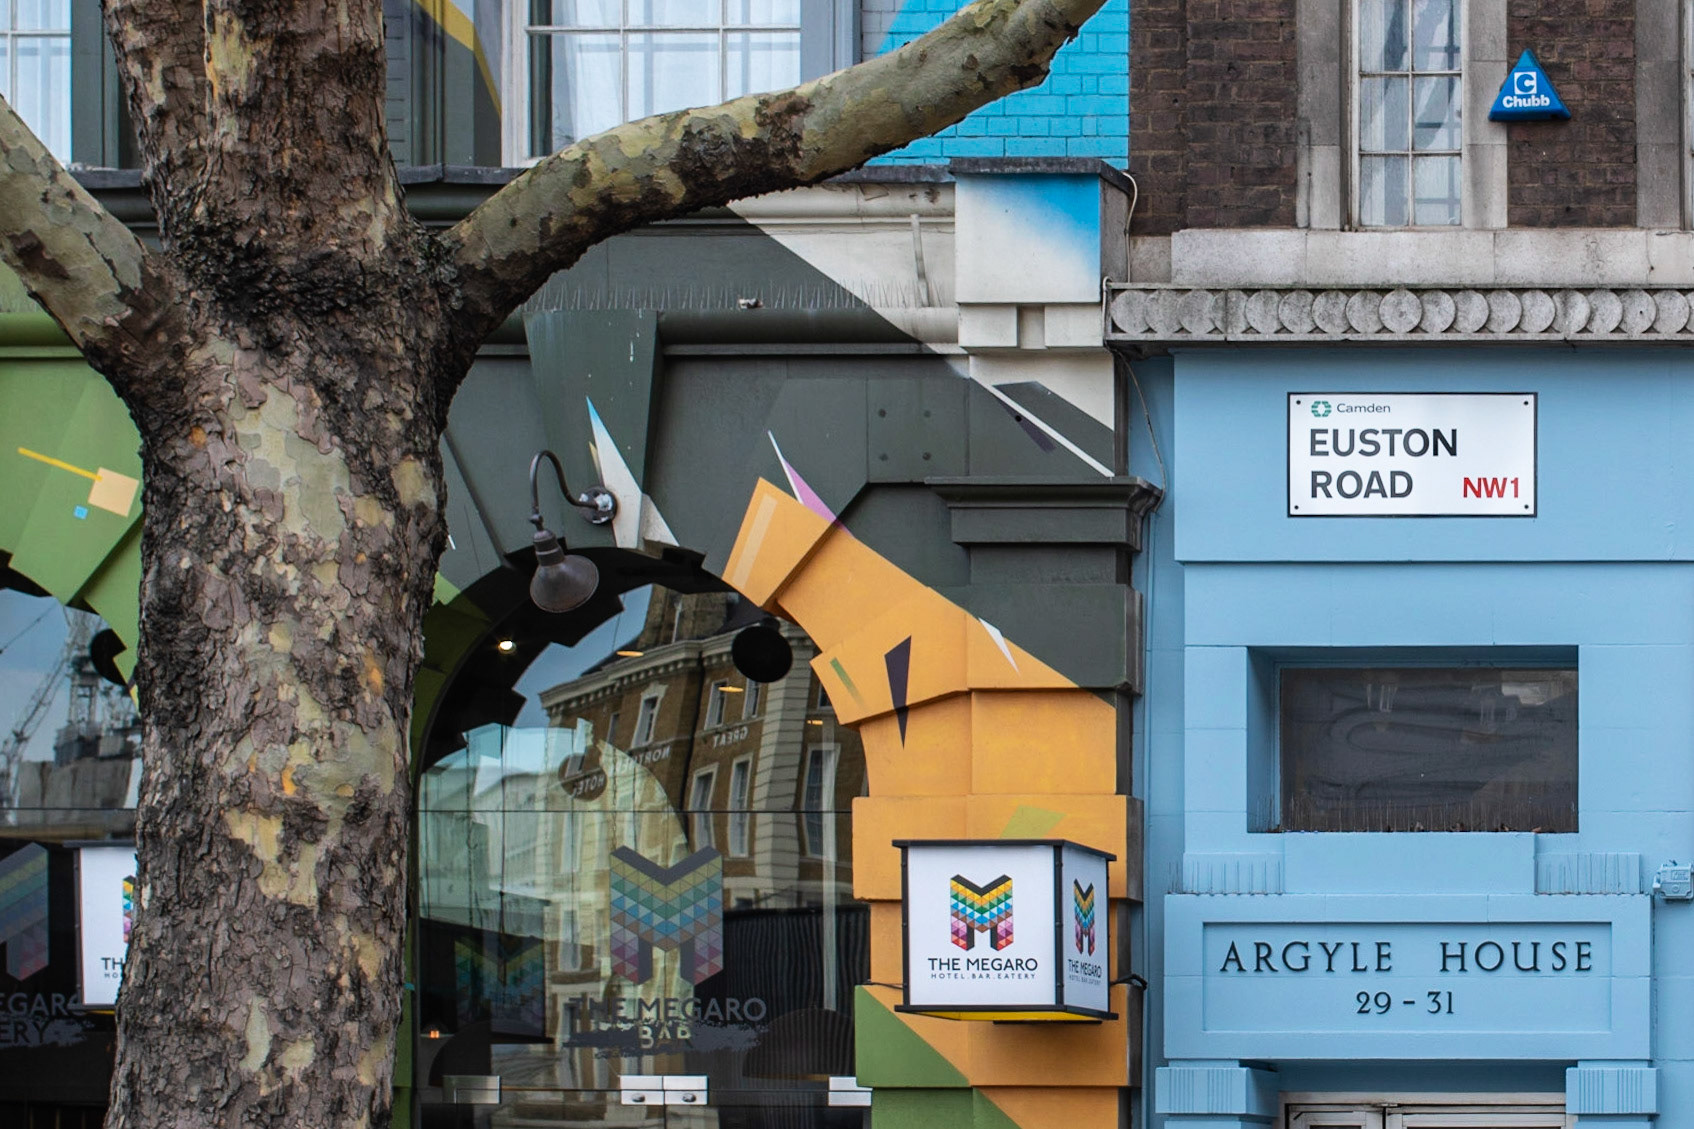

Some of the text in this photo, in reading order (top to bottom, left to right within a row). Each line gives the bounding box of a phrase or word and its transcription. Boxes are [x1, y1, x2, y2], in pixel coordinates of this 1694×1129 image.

[1502, 94, 1551, 108] Chubb
[1336, 402, 1391, 414] Camden
[1310, 428, 1457, 457] EUSTON
[1311, 470, 1519, 499] ROAD NW1
[928, 957, 1038, 971] THE MEGARO
[1068, 959, 1079, 973] THE
[1219, 941, 1593, 972] ARGYLE HOUSE
[638, 997, 767, 1021] MEGARO
